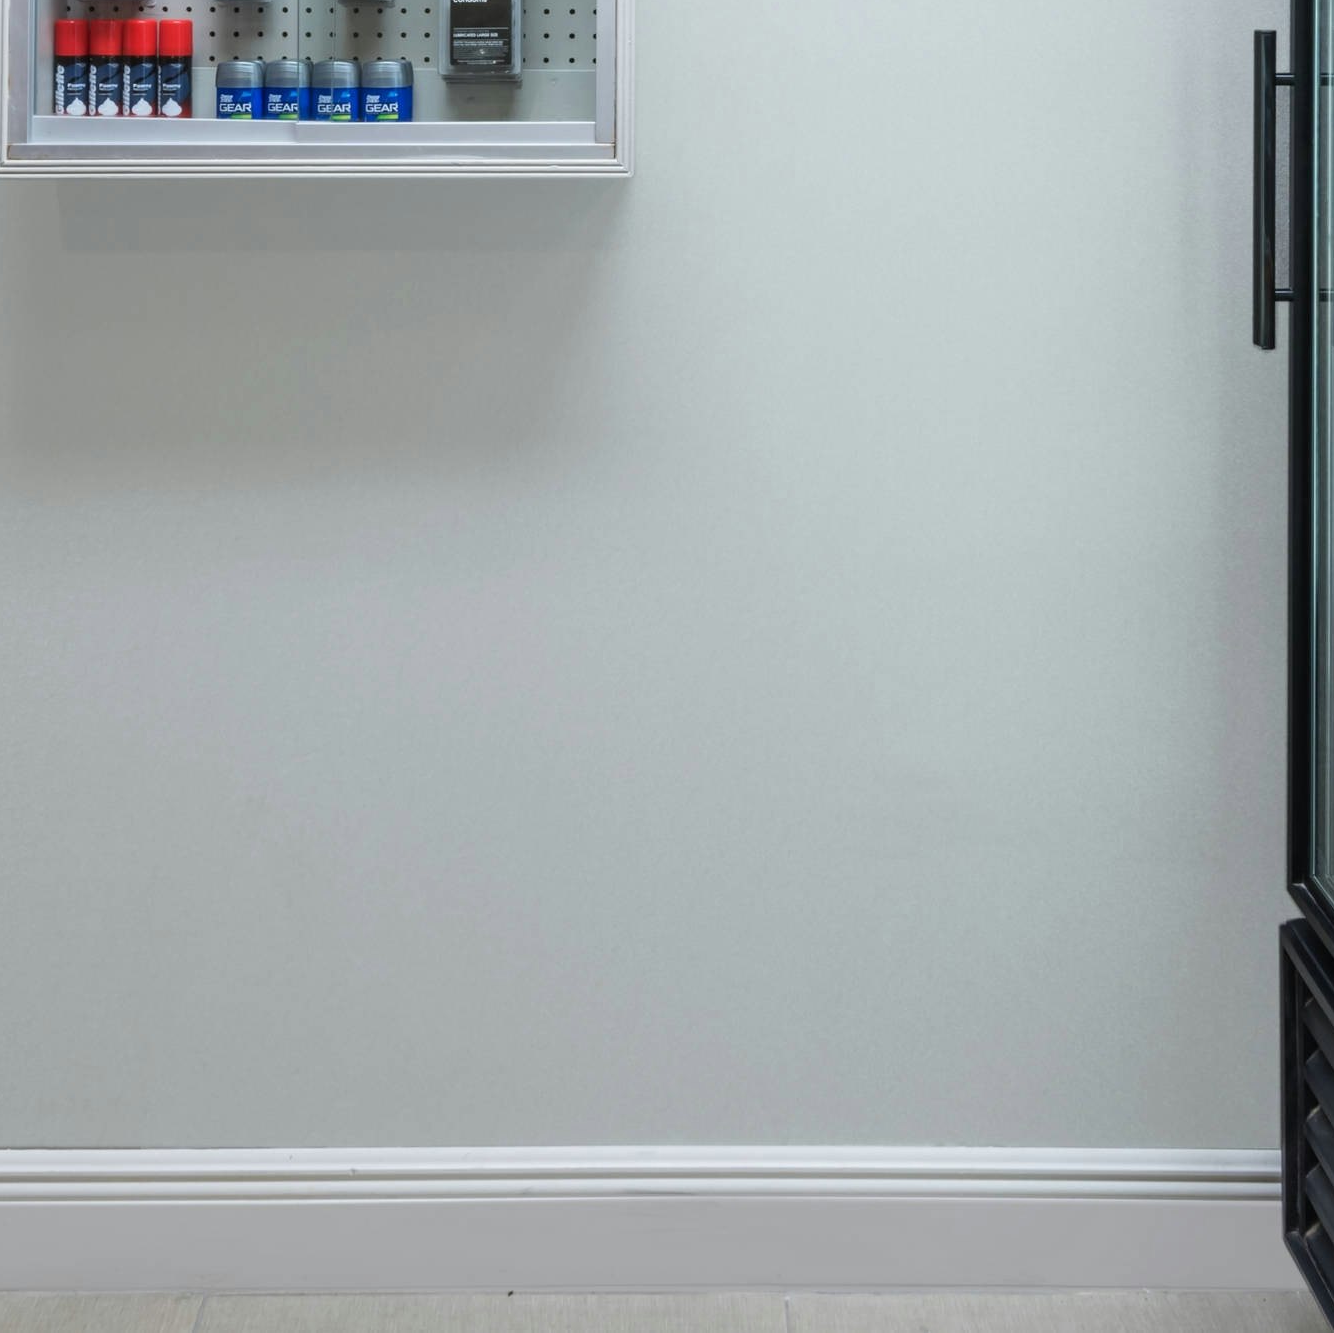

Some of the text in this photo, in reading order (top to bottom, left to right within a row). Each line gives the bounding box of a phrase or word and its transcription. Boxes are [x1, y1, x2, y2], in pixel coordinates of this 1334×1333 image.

[55, 65, 65, 115] Gillette
[219, 103, 252, 112] GEAR
[267, 103, 299, 112] GEAR
[317, 103, 351, 112] GEAR
[365, 103, 398, 112] GEAR
